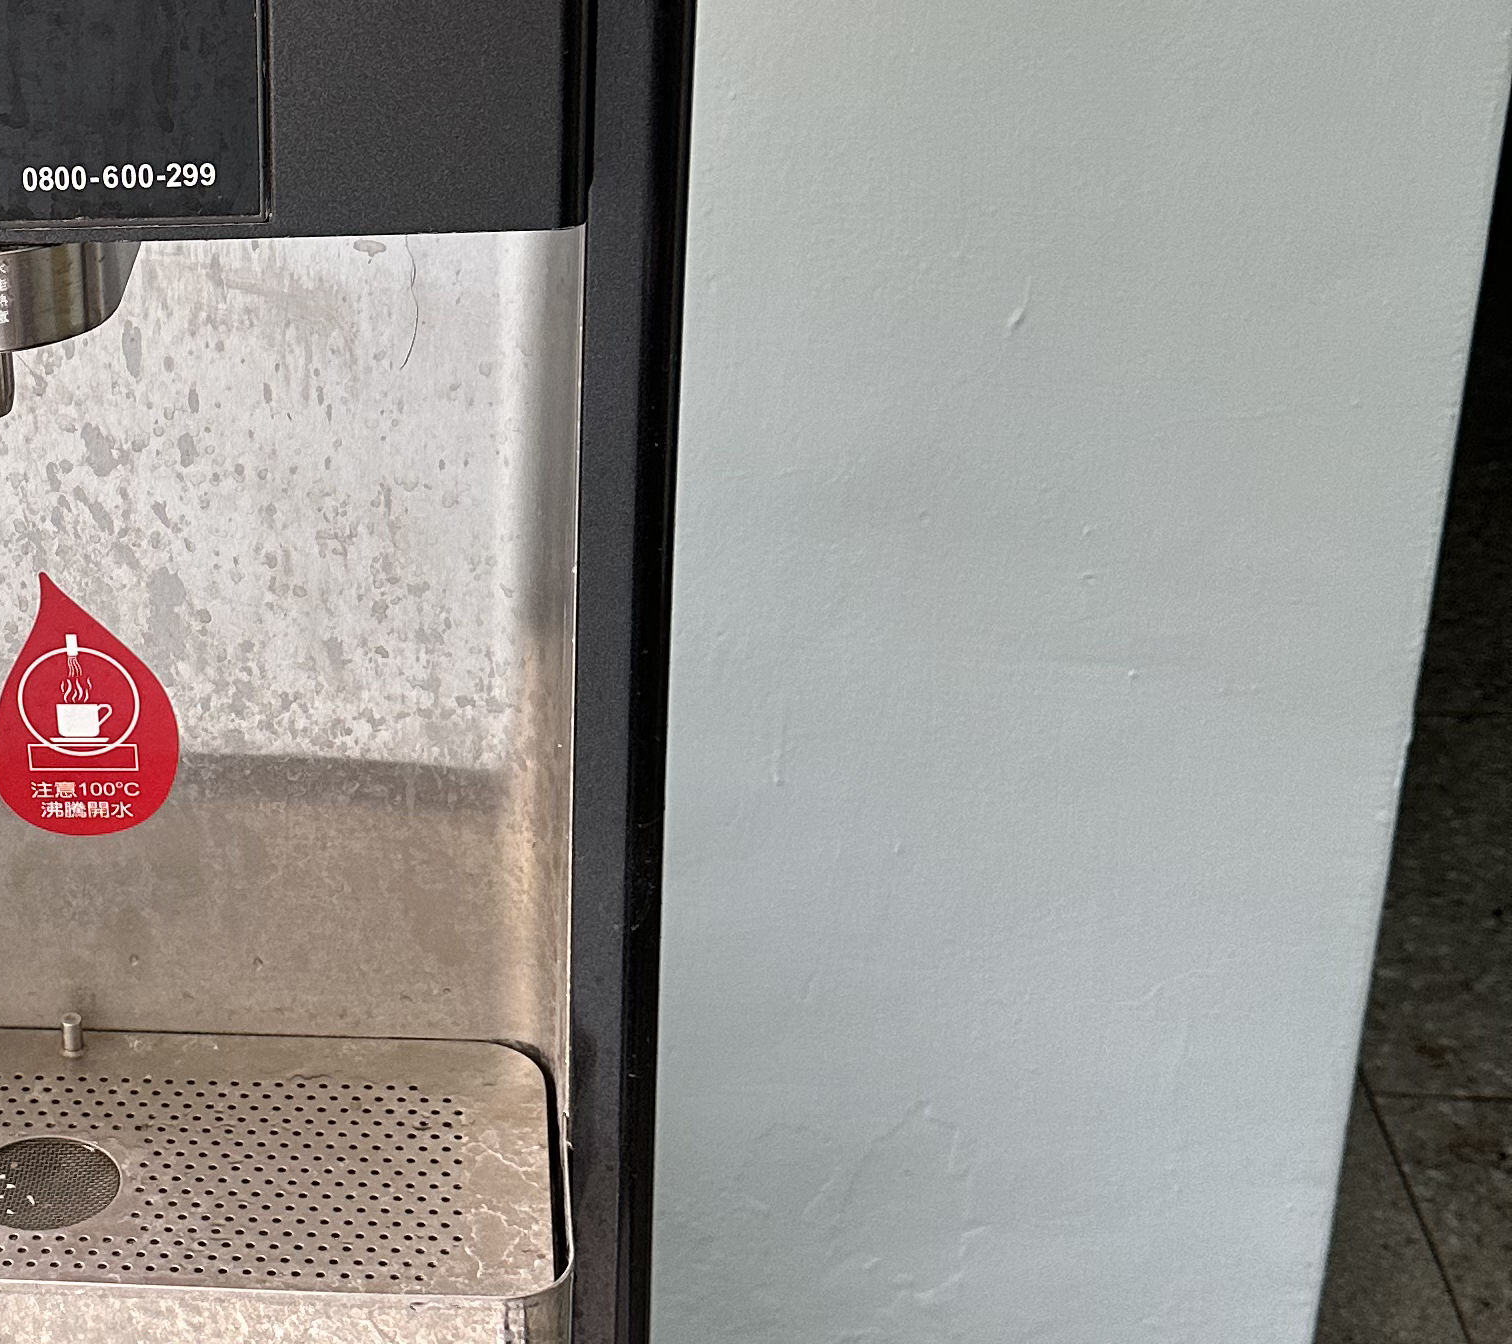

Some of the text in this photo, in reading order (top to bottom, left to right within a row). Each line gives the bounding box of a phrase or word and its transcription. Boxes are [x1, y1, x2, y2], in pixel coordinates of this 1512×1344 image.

[21, 162, 217, 192] 0800-600-299
[40, 801, 134, 819] 沸騰開水
